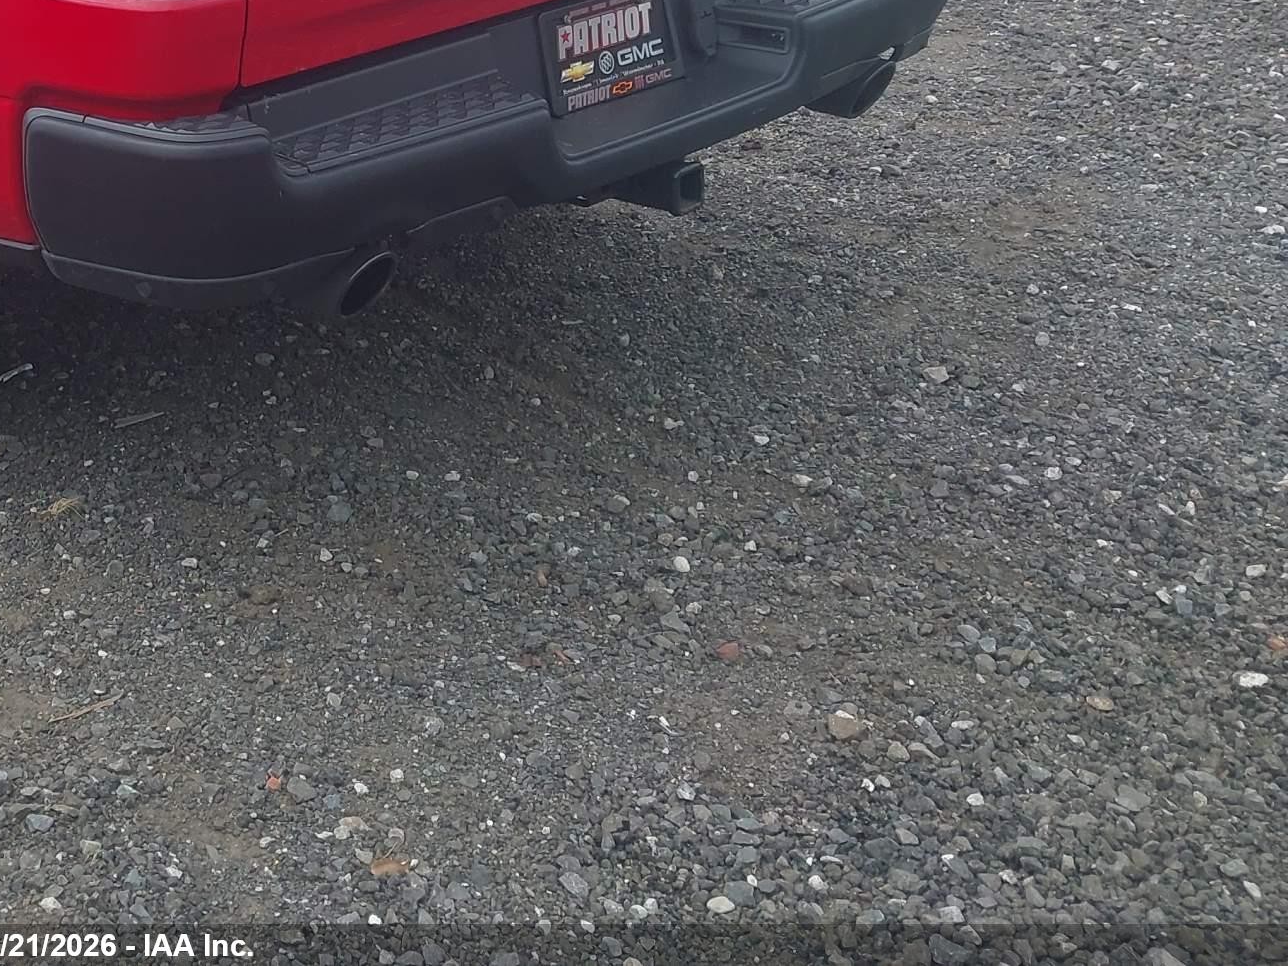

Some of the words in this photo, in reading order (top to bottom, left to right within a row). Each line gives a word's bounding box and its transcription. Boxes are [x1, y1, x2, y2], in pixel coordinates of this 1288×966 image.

[558, 1, 652, 60] PATRIOT
[617, 38, 664, 66] GMC
[645, 68, 672, 84] GMC
[567, 84, 612, 112] PATRIOT
